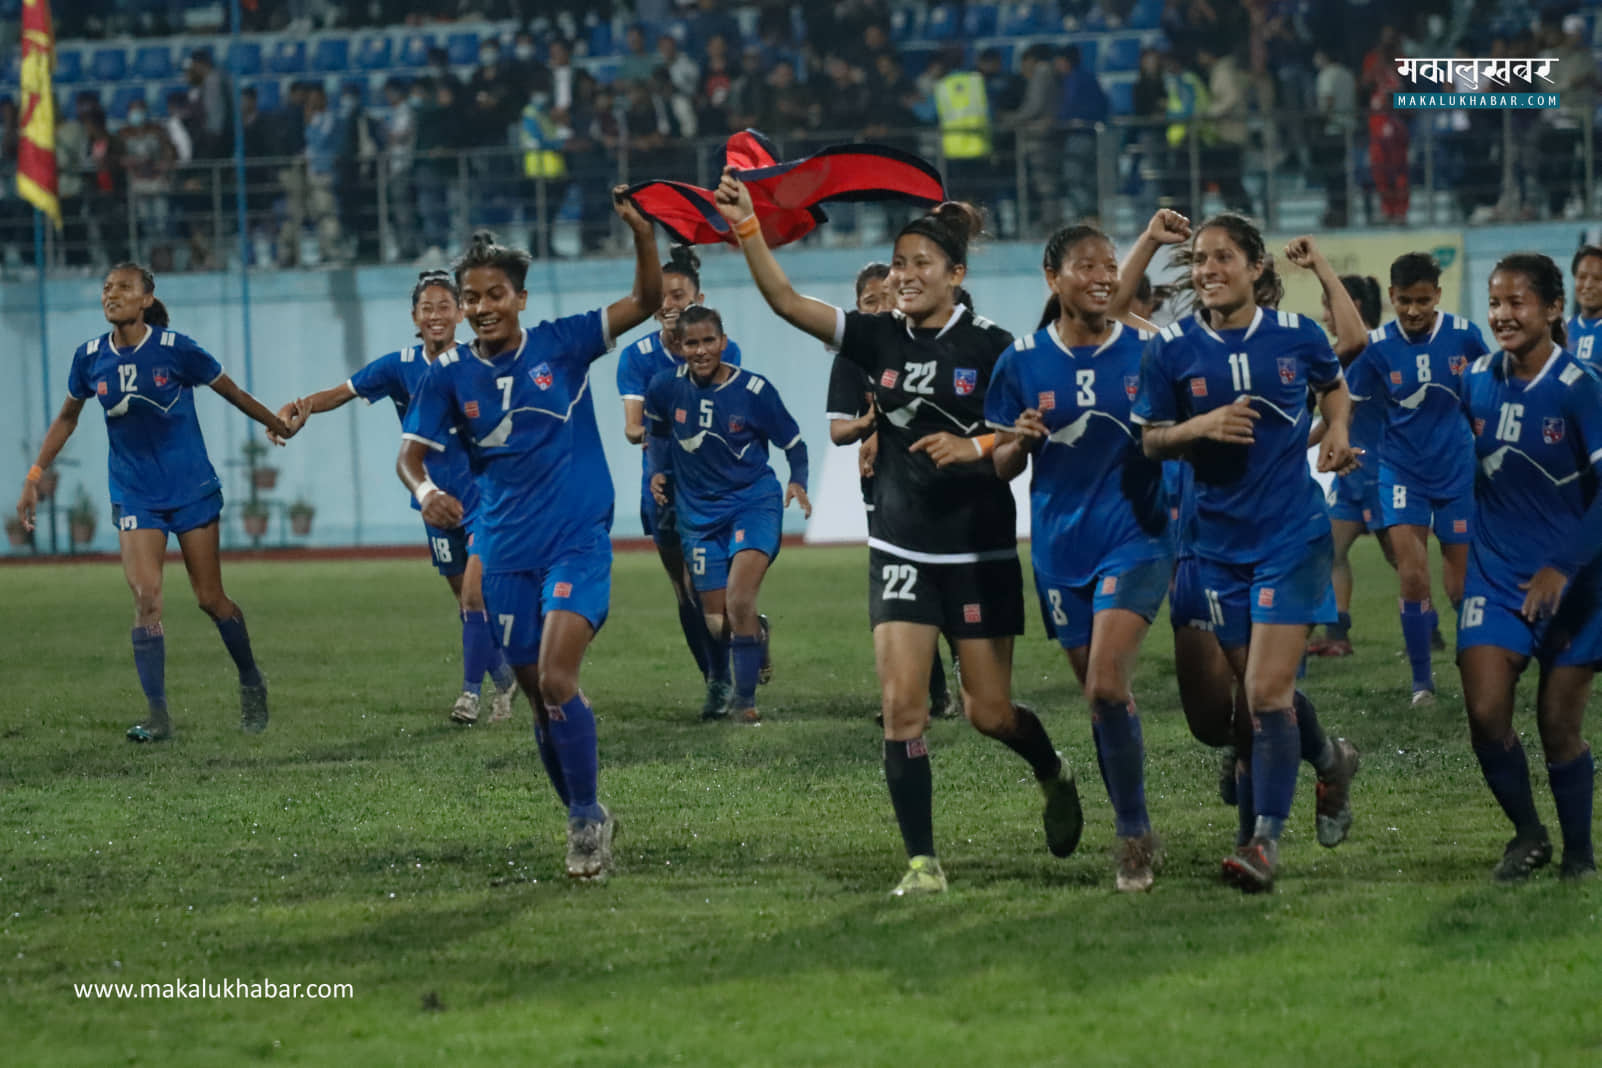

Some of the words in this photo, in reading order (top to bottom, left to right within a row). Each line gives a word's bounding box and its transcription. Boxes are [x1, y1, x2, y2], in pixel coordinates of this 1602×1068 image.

[1576, 335, 1595, 359] 19
[117, 364, 138, 393] 12
[902, 361, 937, 394] 22
[1228, 352, 1251, 391] 11
[1416, 353, 1432, 383] 8
[496, 375, 514, 411] 7
[1076, 369, 1096, 407] 3
[699, 399, 714, 428] 5
[1495, 402, 1525, 442] 16
[1392, 485, 1406, 509] 8
[431, 536, 453, 564] 18
[692, 547, 706, 575] 5
[882, 564, 917, 601] 22
[1047, 589, 1069, 626] 3
[1460, 596, 1486, 628] 16
[498, 614, 514, 647] 7
